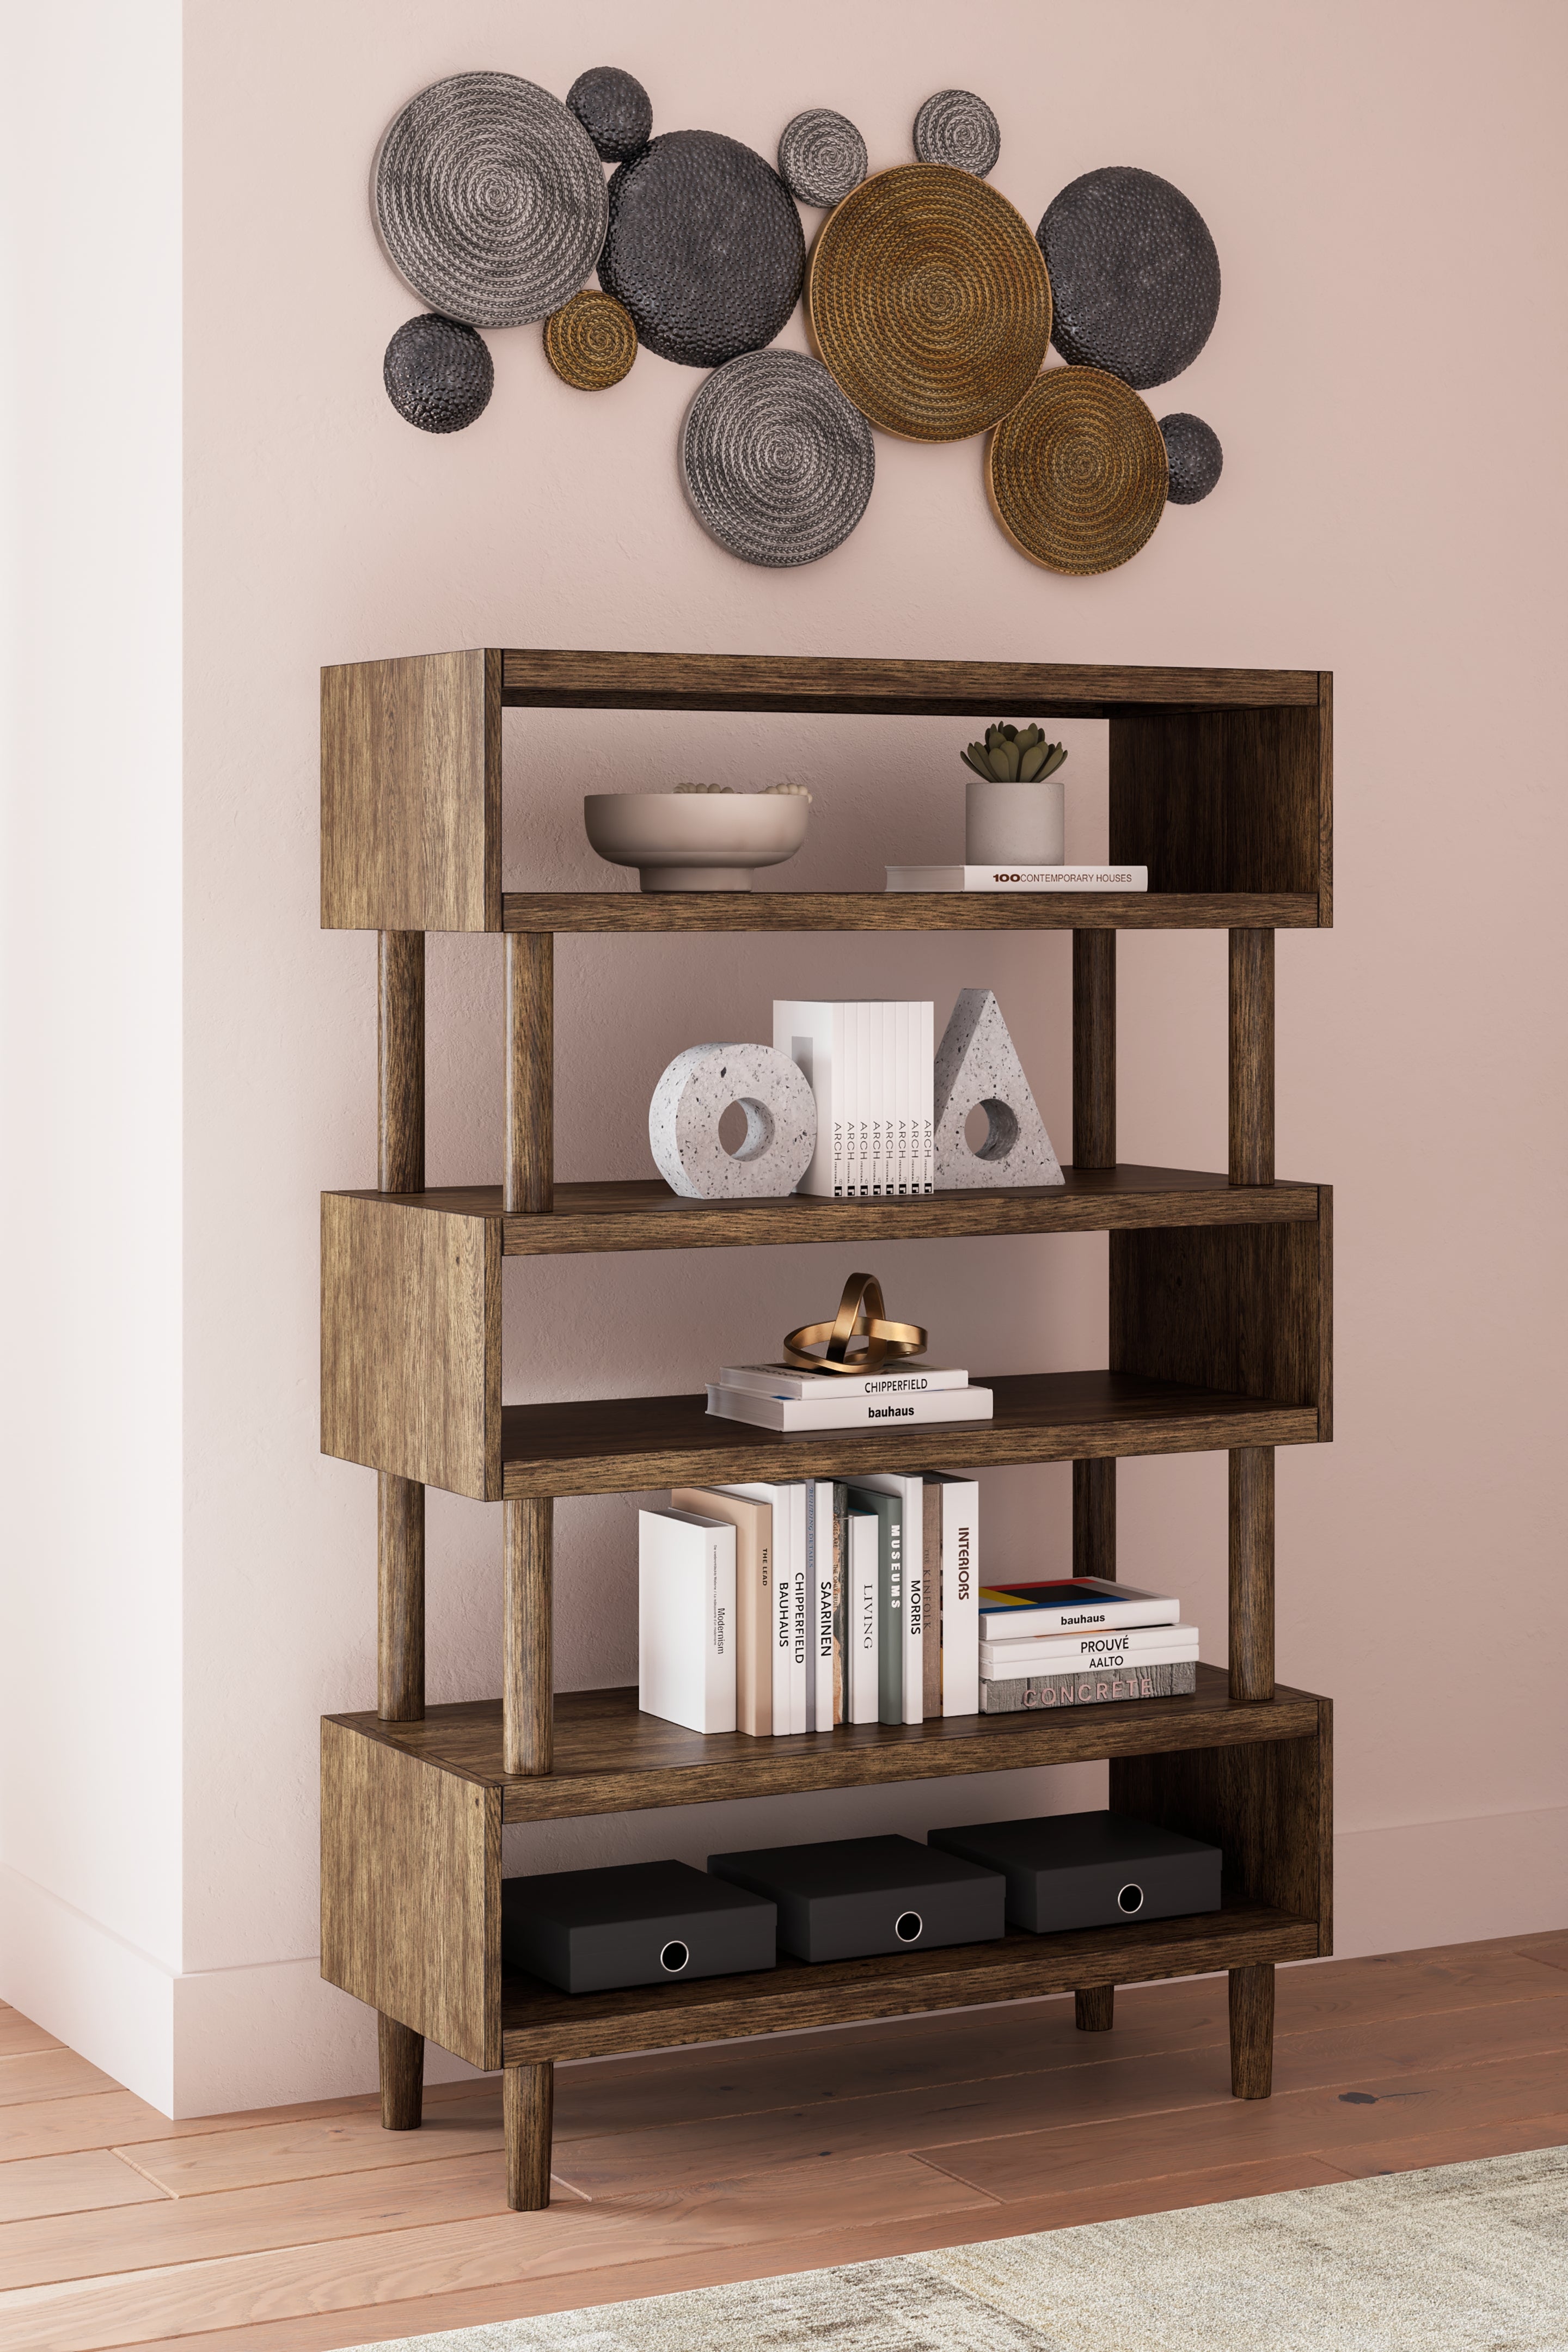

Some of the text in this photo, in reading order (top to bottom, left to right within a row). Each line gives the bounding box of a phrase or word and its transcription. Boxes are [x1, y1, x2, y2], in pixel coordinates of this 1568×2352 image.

[865, 1379, 927, 1393] CHIPPERFIELD
[869, 1406, 914, 1418] bauhaus
[891, 1525, 900, 1608] MUSEUMS
[959, 1528, 969, 1600] INTERIORS
[780, 1583, 788, 1647] BAUHAUS
[795, 1573, 804, 1663] CHIPPERFIELD
[821, 1582, 831, 1656] SAARINEN
[864, 1585, 872, 1649] LIVING
[911, 1581, 921, 1634] MORRIS
[1061, 1615, 1105, 1625] bauhaus
[1081, 1635, 1129, 1653] PROUVÉ
[1089, 1656, 1123, 1668] AALTO
[1023, 1679, 1152, 1707] CONCRETE
